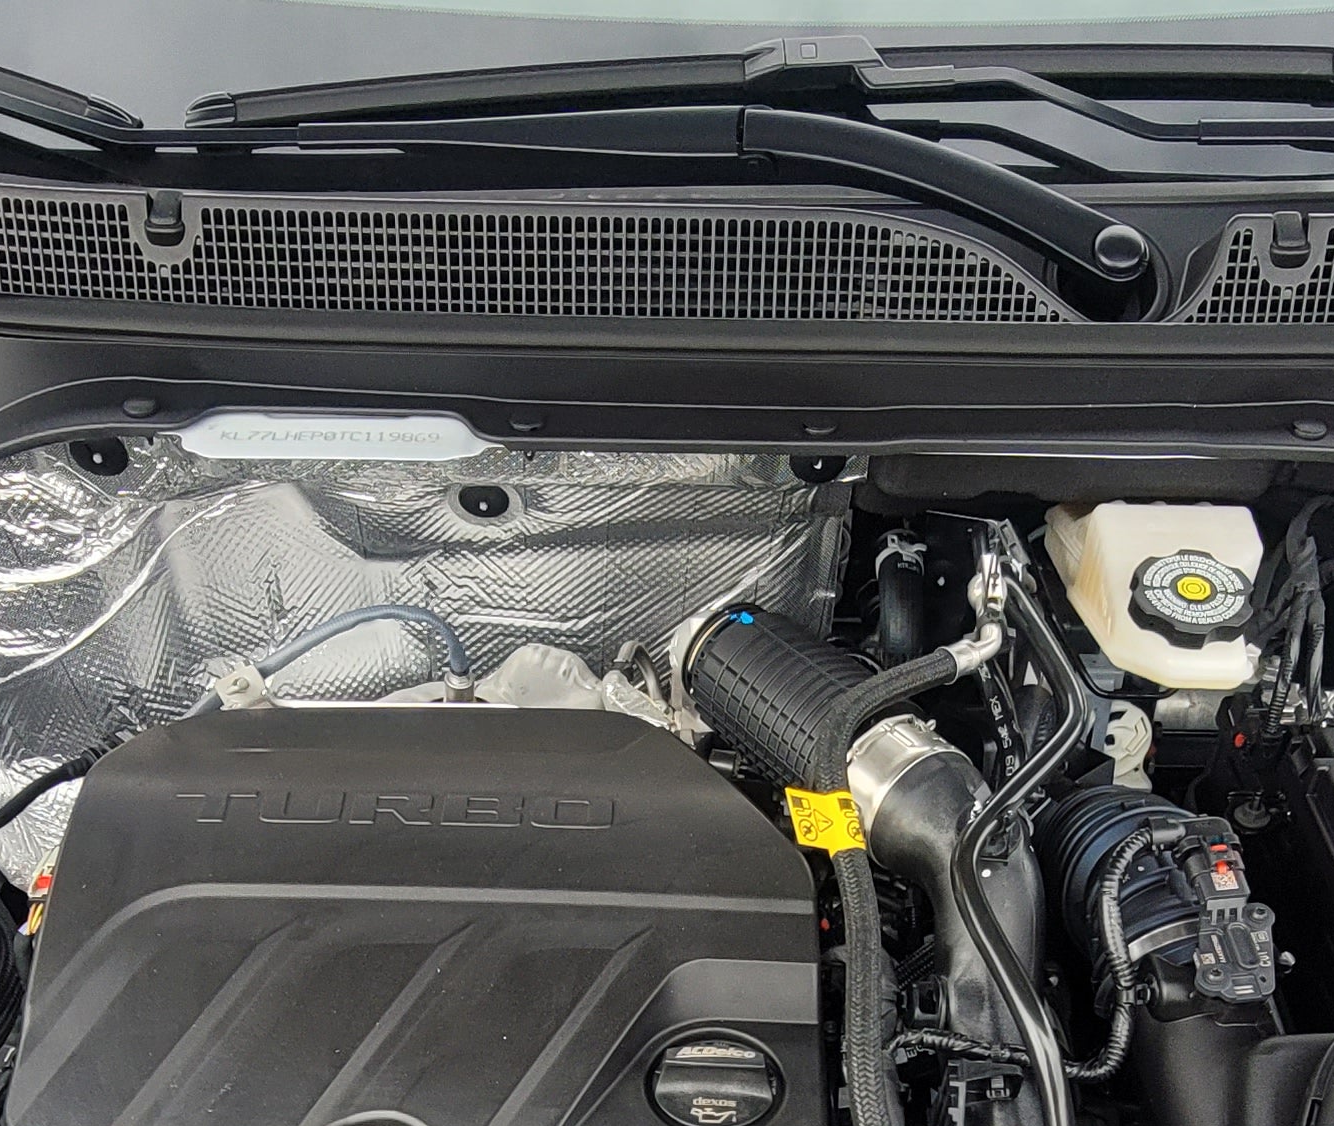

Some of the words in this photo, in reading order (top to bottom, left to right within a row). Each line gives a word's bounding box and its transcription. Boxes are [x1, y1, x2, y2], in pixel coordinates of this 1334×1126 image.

[176, 790, 615, 830] TURBO
[675, 1046, 756, 1059] ACDelco
[692, 1097, 737, 1107] dexos
